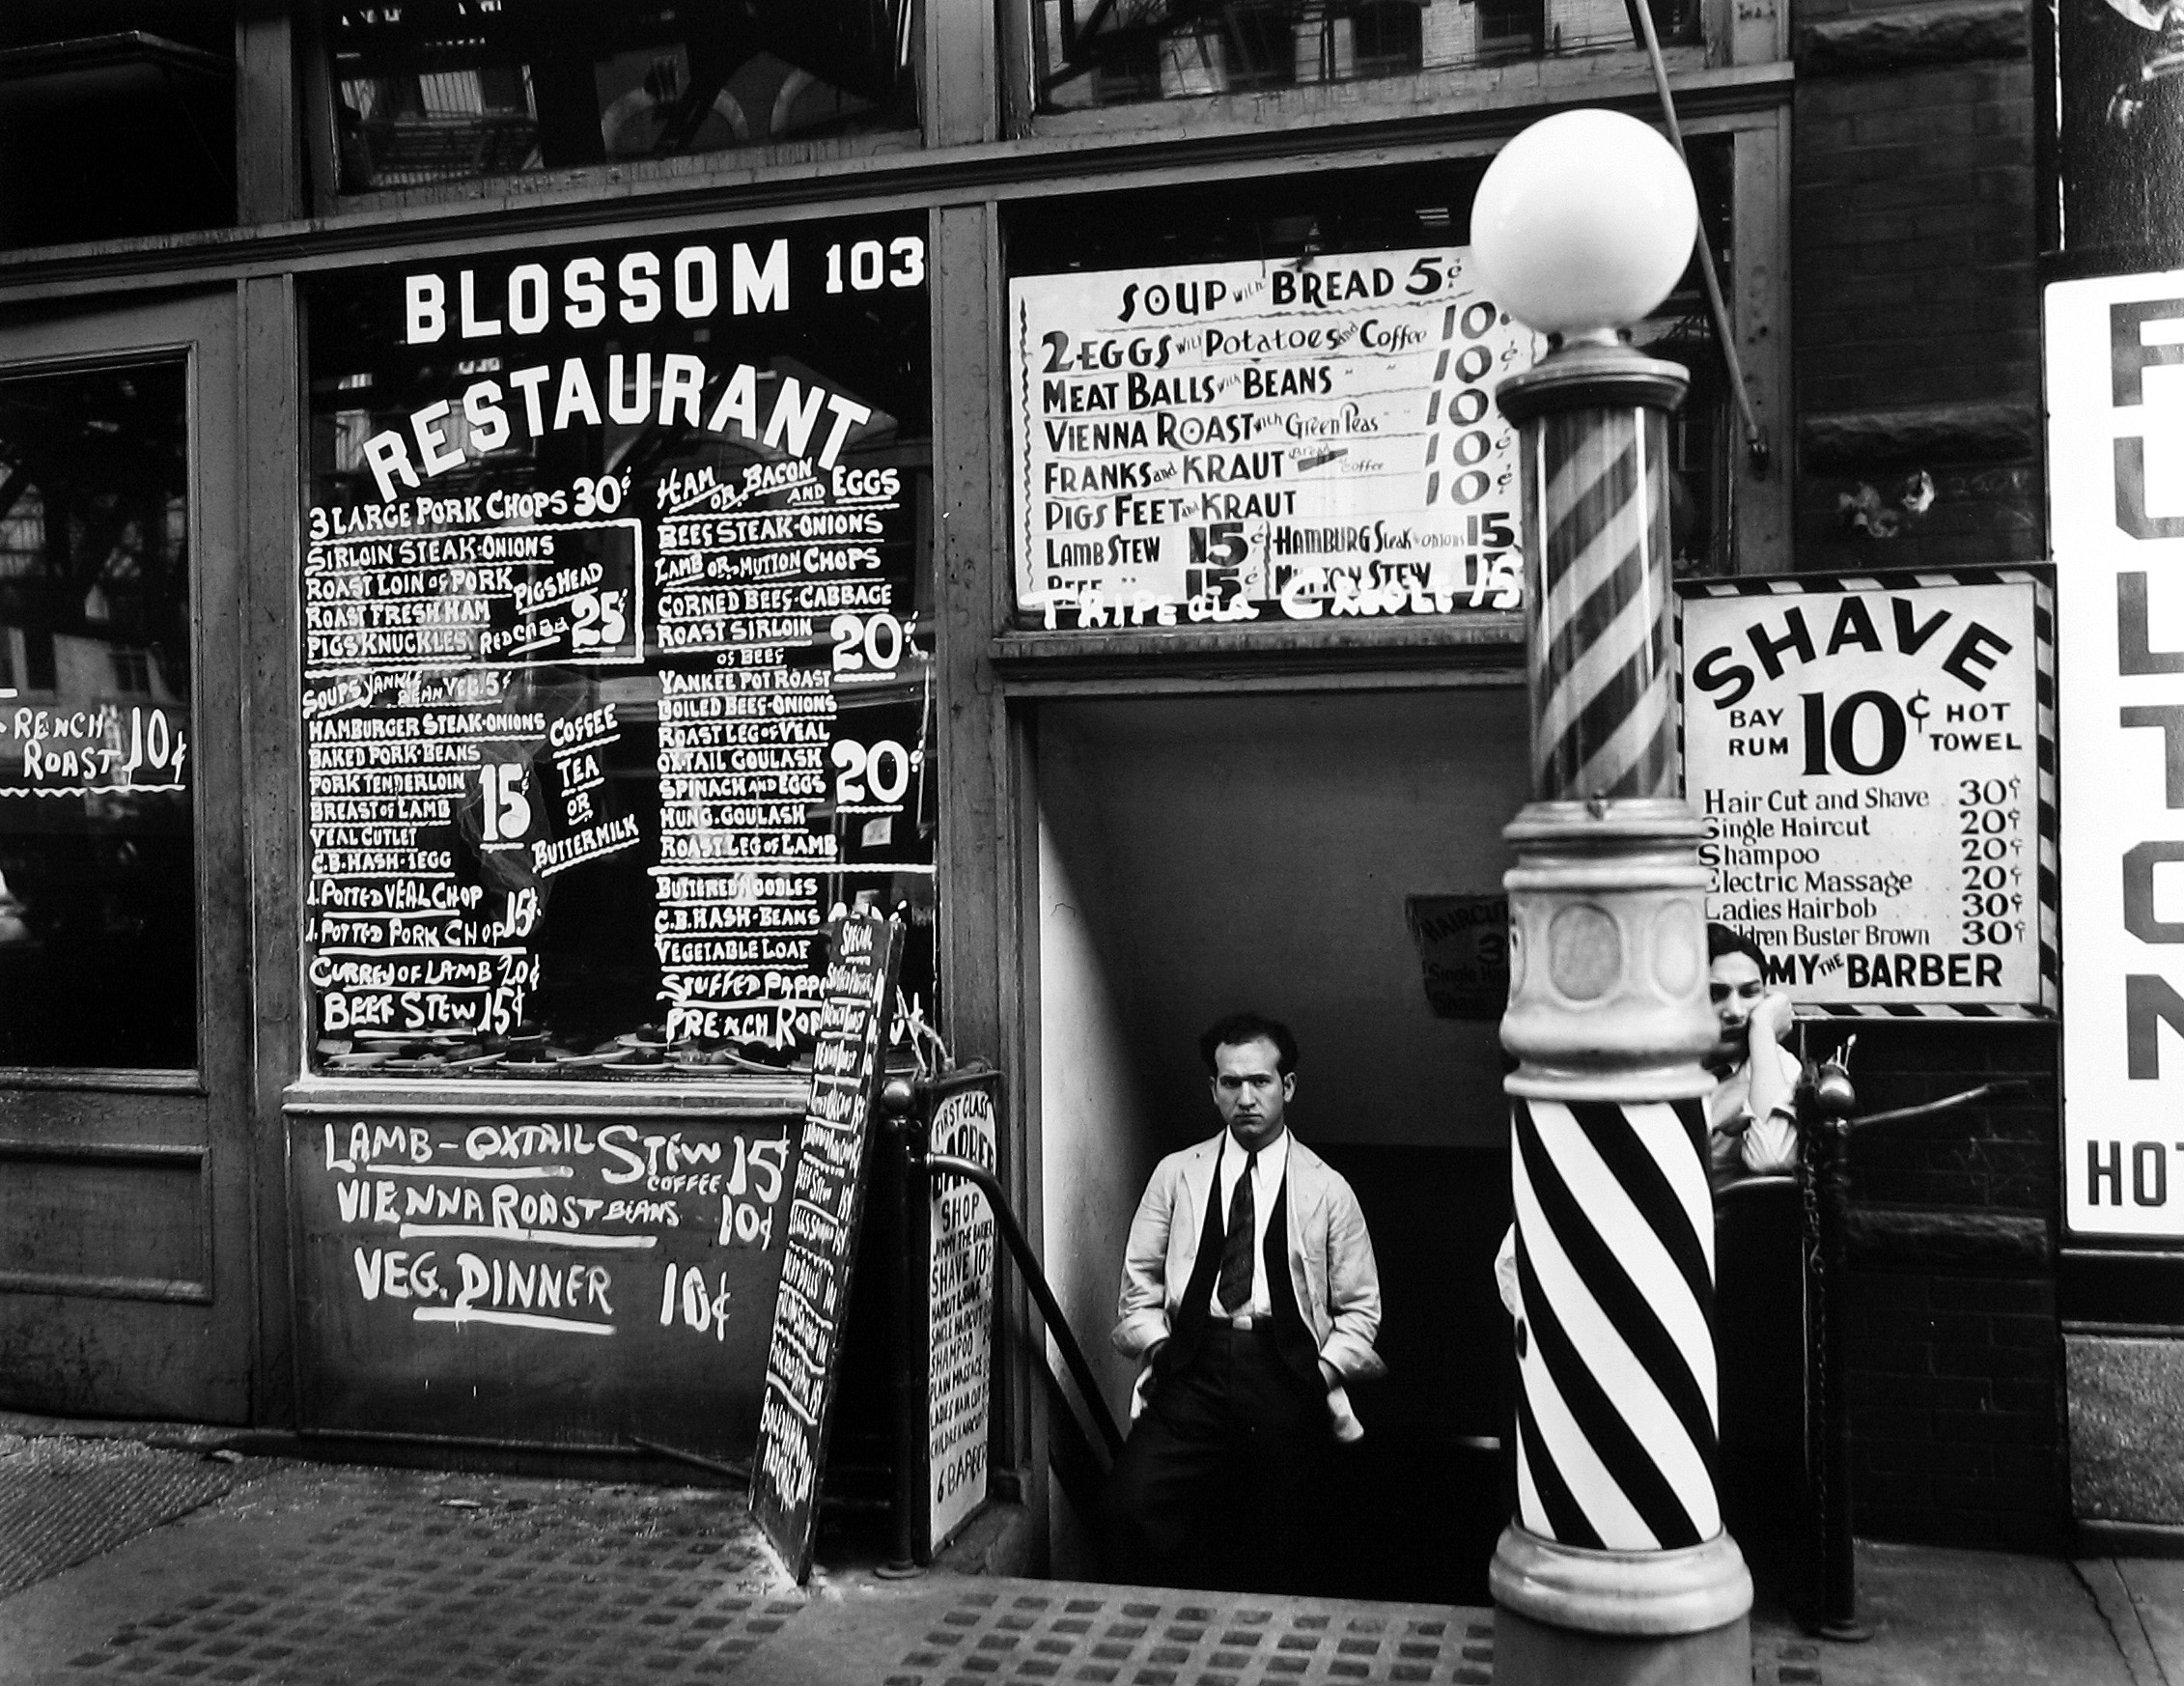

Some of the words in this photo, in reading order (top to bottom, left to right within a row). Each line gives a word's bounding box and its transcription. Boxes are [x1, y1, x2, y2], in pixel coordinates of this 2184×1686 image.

[405, 238, 790, 345] BLOSSOM
[825, 236, 925, 294] 103
[1117, 280, 1226, 323] SOUP
[1273, 268, 1395, 308] BREAD
[1043, 379, 1120, 413] MEAT
[1128, 372, 1215, 410] BALLS
[1244, 366, 1331, 399] BEANS
[362, 352, 871, 501] RESTAURANT
[1044, 420, 1148, 452] VIENNA
[1158, 412, 1254, 451] ROAST
[657, 466, 715, 510] HAM
[743, 457, 813, 489] BACON
[788, 484, 826, 503] AND
[832, 465, 900, 496] EGGS
[1045, 462, 1151, 493] FRANKS
[1183, 451, 1284, 483] KRAUT
[310, 507, 329, 540] 3
[333, 502, 410, 535] LARGE
[416, 496, 481, 526] PORK
[486, 490, 567, 520] CHOPS
[1045, 502, 1107, 530] PIGS
[1115, 493, 1184, 527] FEET
[1201, 491, 1296, 520] KRAUT
[1047, 539, 1104, 568] LAMB
[1108, 535, 1160, 565] STEW
[1274, 525, 1370, 555] HAMBURG
[306, 541, 393, 573] SIRLOIN
[741, 550, 801, 577] MUTTON
[803, 548, 881, 572] CHOPS
[305, 576, 373, 600] ROAST
[378, 575, 425, 597] LOIN
[450, 567, 513, 593] PORK
[305, 606, 368, 629] ROAST
[372, 604, 443, 626] FRESH
[444, 600, 490, 623] HAM
[658, 593, 740, 618] CORNED
[307, 635, 356, 659] PIGS
[657, 622, 725, 647] ROAST
[730, 618, 812, 641] SIRLOIN
[1693, 596, 2013, 710] SHAVE
[658, 670, 736, 693] YANKEE
[740, 672, 771, 689] POT
[774, 668, 831, 688] ROAST
[0, 707, 103, 739] RENCH
[309, 717, 420, 742] HAMBURGER
[550, 703, 618, 747] COFFEE
[1729, 709, 1784, 728] BAY
[1946, 703, 2010, 722] HOT
[658, 725, 722, 747] ROAST
[725, 724, 759, 743] LEG
[778, 722, 830, 742] VEAL
[1728, 737, 1788, 756] RUM
[1929, 733, 2023, 750] TOWEL
[24, 739, 121, 780] ROAST
[309, 747, 366, 769] BAKED
[557, 755, 601, 787] TEA
[731, 748, 822, 770] GOULASH
[310, 774, 360, 795] PORK
[364, 772, 465, 793] TENDERLOIN
[658, 778, 745, 800] SPINACH
[778, 774, 826, 794] EGGS
[310, 801, 378, 821] BREAST
[399, 798, 450, 819] LAMB
[1704, 790, 1762, 813] Hair
[1768, 789, 1807, 811] Cut
[1816, 789, 1859, 810] and
[1864, 787, 1928, 808] Shave
[310, 829, 358, 847] VEAL
[361, 828, 417, 847] CUTLET
[531, 814, 639, 873] BUTTERMILK
[660, 835, 725, 857] ROAST
[728, 836, 761, 856] LEG
[782, 834, 838, 856] LAMB
[1703, 817, 1774, 845] Single
[1781, 816, 1870, 837] Haircut
[1698, 844, 1819, 869] Shampoo
[385, 879, 432, 910] VEAL
[433, 882, 483, 909] CHOP
[1805, 871, 1912, 897] Massage
[1705, 897, 1781, 920] Ladies
[1788, 897, 1876, 919] Hairbob
[389, 919, 439, 947] PORK
[444, 919, 505, 945] CHOP
[1793, 924, 1860, 945] Buster
[1865, 925, 1929, 945] Brown
[656, 941, 757, 964] VEGETABLE
[762, 939, 811, 960] LOAF
[425, 961, 491, 984] LAMB
[1817, 952, 1844, 976] THE
[1847, 953, 2002, 989] BARBER
[324, 992, 393, 1030] BEEF
[401, 991, 475, 1028] STEW
[599, 1124, 722, 1183] STEW
[647, 1174, 722, 1194] COFFEE
[2087, 1140, 2184, 1206] HO
[337, 1180, 485, 1224] VIENNA
[492, 1185, 604, 1229] ROAST
[941, 1193, 979, 1232] SHOP
[456, 1252, 613, 1314] DINNER
[932, 1250, 969, 1298] SHAVE
